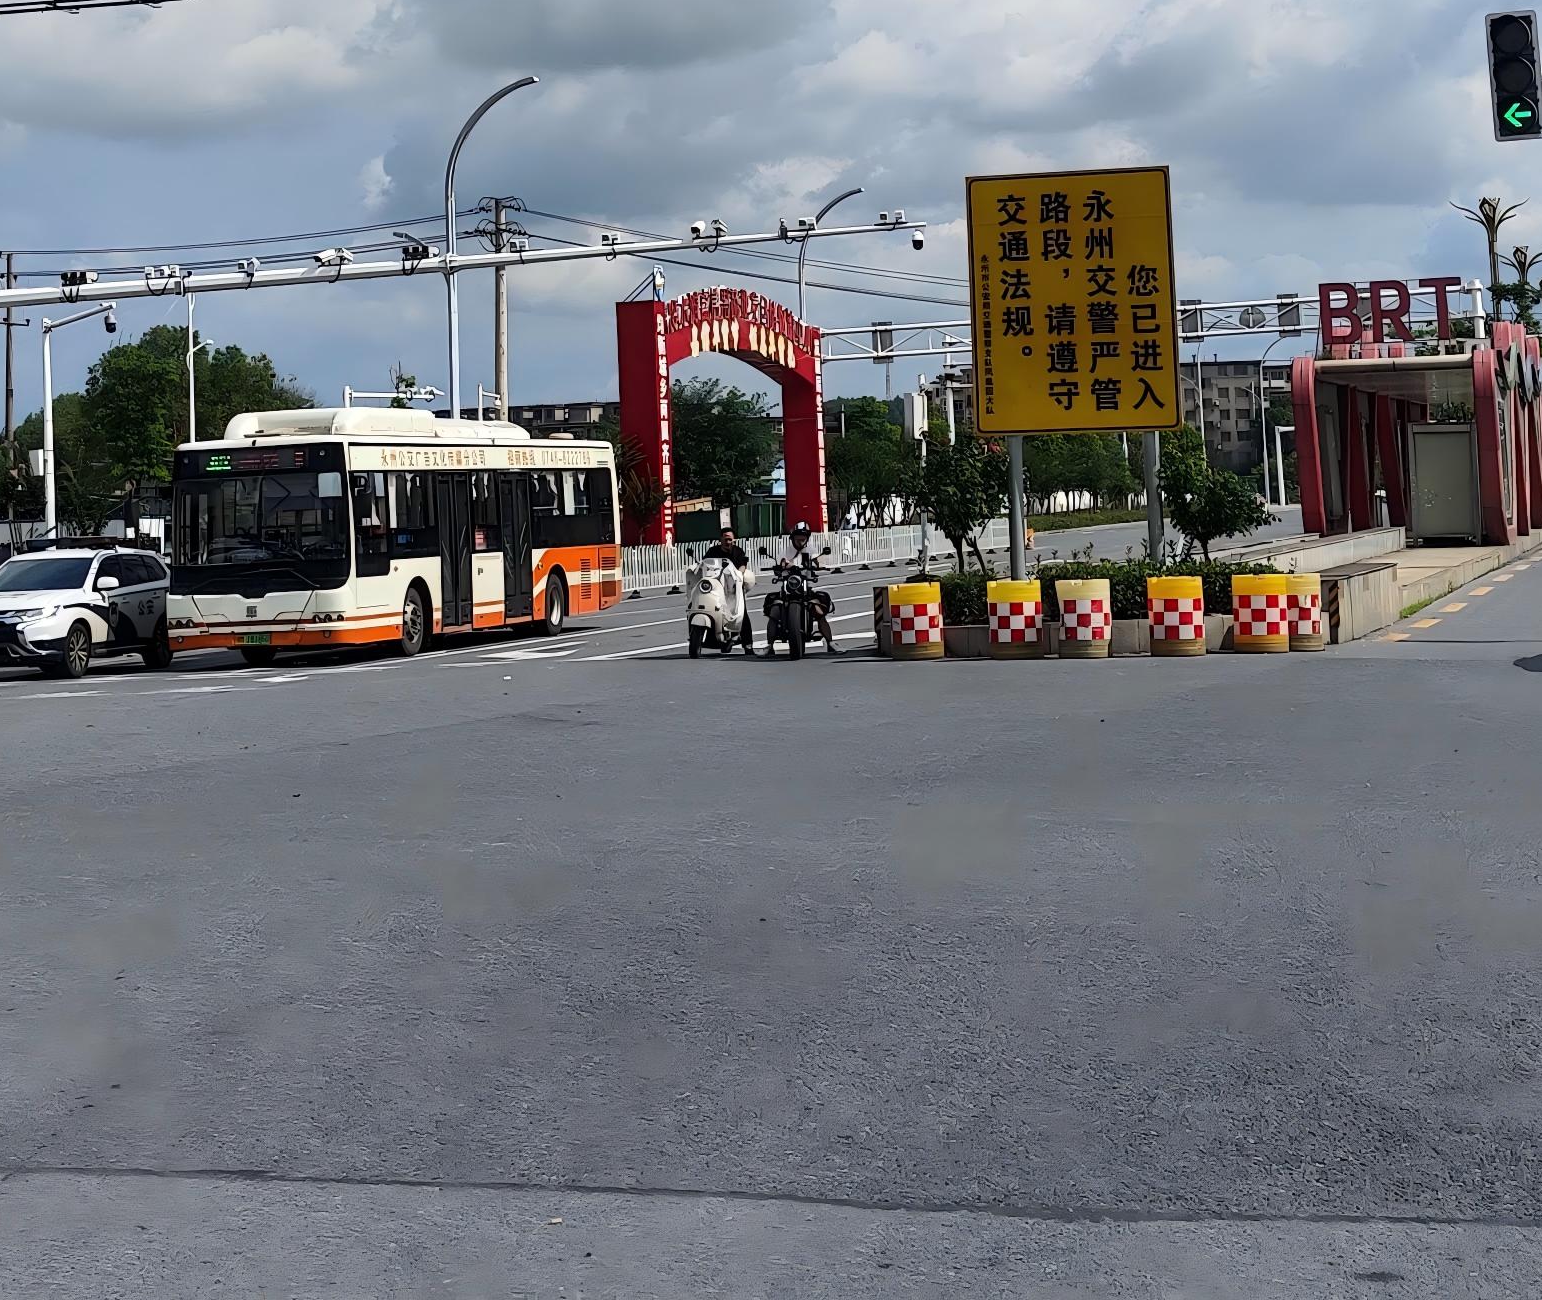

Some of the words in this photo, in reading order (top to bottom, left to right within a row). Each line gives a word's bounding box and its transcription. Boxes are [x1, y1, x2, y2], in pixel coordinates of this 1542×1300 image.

[1082, 189, 1121, 412] 永州交警严管
[1126, 264, 1165, 411] 您已进入
[1318, 276, 1462, 345] BRT
